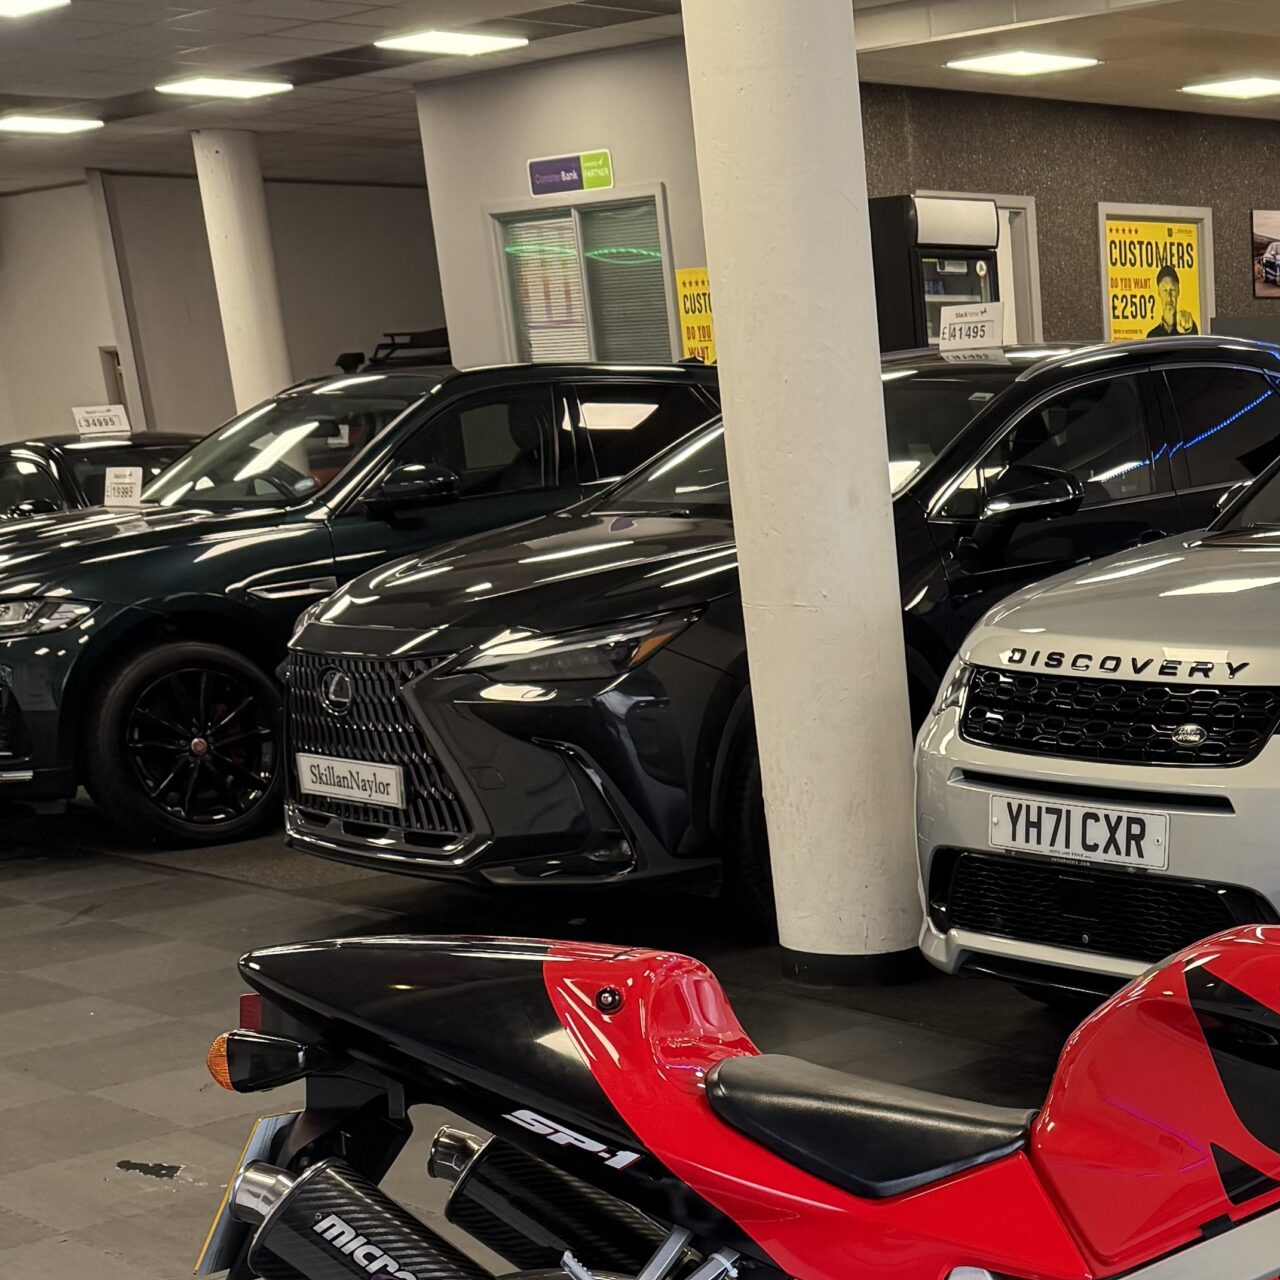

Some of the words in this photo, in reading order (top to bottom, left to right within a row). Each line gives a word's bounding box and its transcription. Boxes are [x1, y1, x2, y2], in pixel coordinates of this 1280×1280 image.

[1109, 239, 1194, 269] CUSTOMERS
[1110, 277, 1119, 289] DO
[1120, 277, 1132, 290] YOU
[1133, 278, 1151, 290] WANT
[1111, 293, 1156, 321] £250?
[686, 325, 696, 341] DO
[697, 324, 711, 340] YOU
[941, 324, 986, 341] £41495
[1006, 647, 1250, 680] DISCOVERY
[309, 764, 391, 798] SkillanNaylor
[1006, 801, 1072, 850] YH71
[1081, 811, 1147, 859] CXR
[501, 1109, 645, 1172] SP-1
